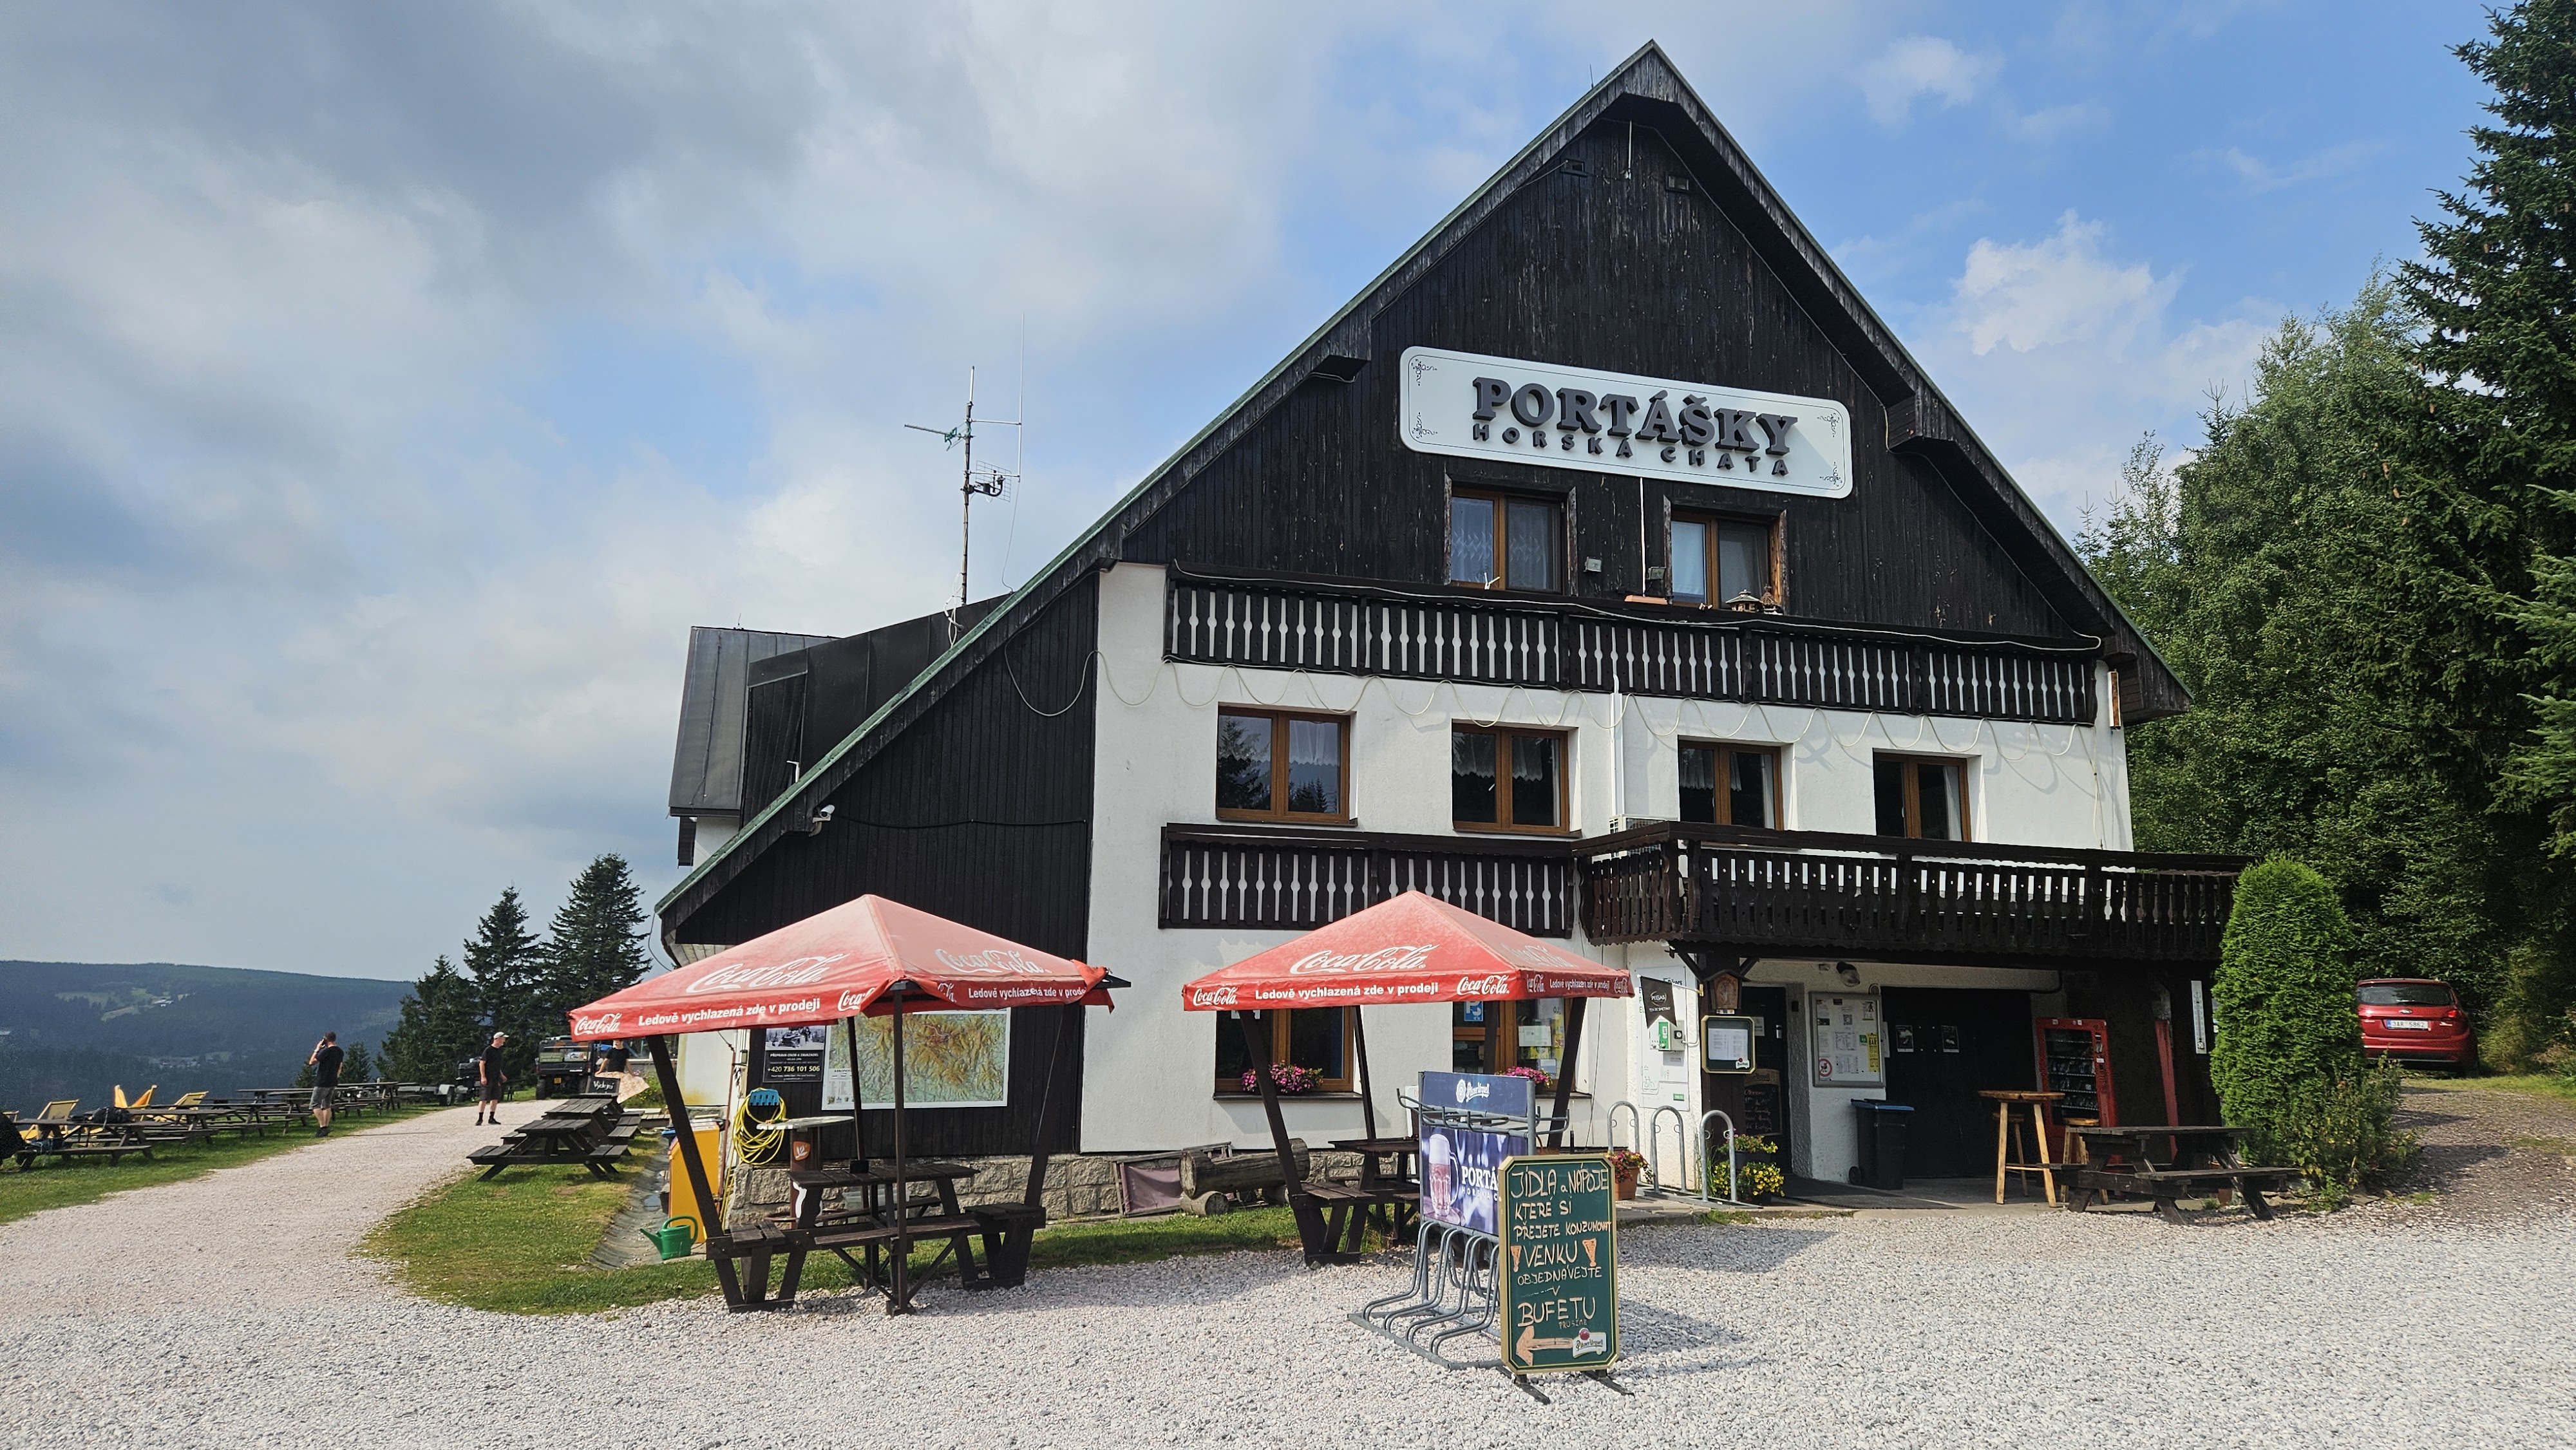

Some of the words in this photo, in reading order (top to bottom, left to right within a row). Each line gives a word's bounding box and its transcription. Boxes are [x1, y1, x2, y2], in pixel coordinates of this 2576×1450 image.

[1472, 377, 1798, 456] PORTÁŠKY
[1472, 424, 1634, 458] HORSKÁ
[1660, 446, 1789, 476] CHATA
[935, 949, 1045, 974] Coca-Cola
[1290, 944, 1440, 975] Coca-Cola
[686, 954, 851, 993] Coca-Cola
[1457, 975, 1510, 995] Coca-Cola
[969, 988, 998, 998] Ledově
[1044, 988, 1057, 997] zde
[1193, 986, 1238, 1006] Coca-Cola
[1255, 988, 1295, 1000] Ledově
[1298, 986, 1361, 999] vychlazená
[1363, 986, 1384, 995] zde
[1397, 983, 1438, 996] prodeji
[574, 1013, 622, 1036] Coca-Cola
[638, 1012, 677, 1026] Ledově
[681, 1004, 743, 1024] vychlazená
[746, 1005, 766, 1016] zde
[769, 1004, 775, 1013] v
[779, 998, 820, 1015] prodeji
[1511, 1165, 1557, 1198] JÍDLA
[1560, 1184, 1568, 1193] a
[1567, 1163, 1609, 1194] NÁPOJE
[1515, 1196, 1553, 1221] KTERÉ
[1513, 1220, 1561, 1243] PŘEJETE
[1523, 1240, 1578, 1268] VENKU
[1517, 1264, 1603, 1286] OBJEDNÁVEJTE
[1517, 1297, 1596, 1327] BUFETU
